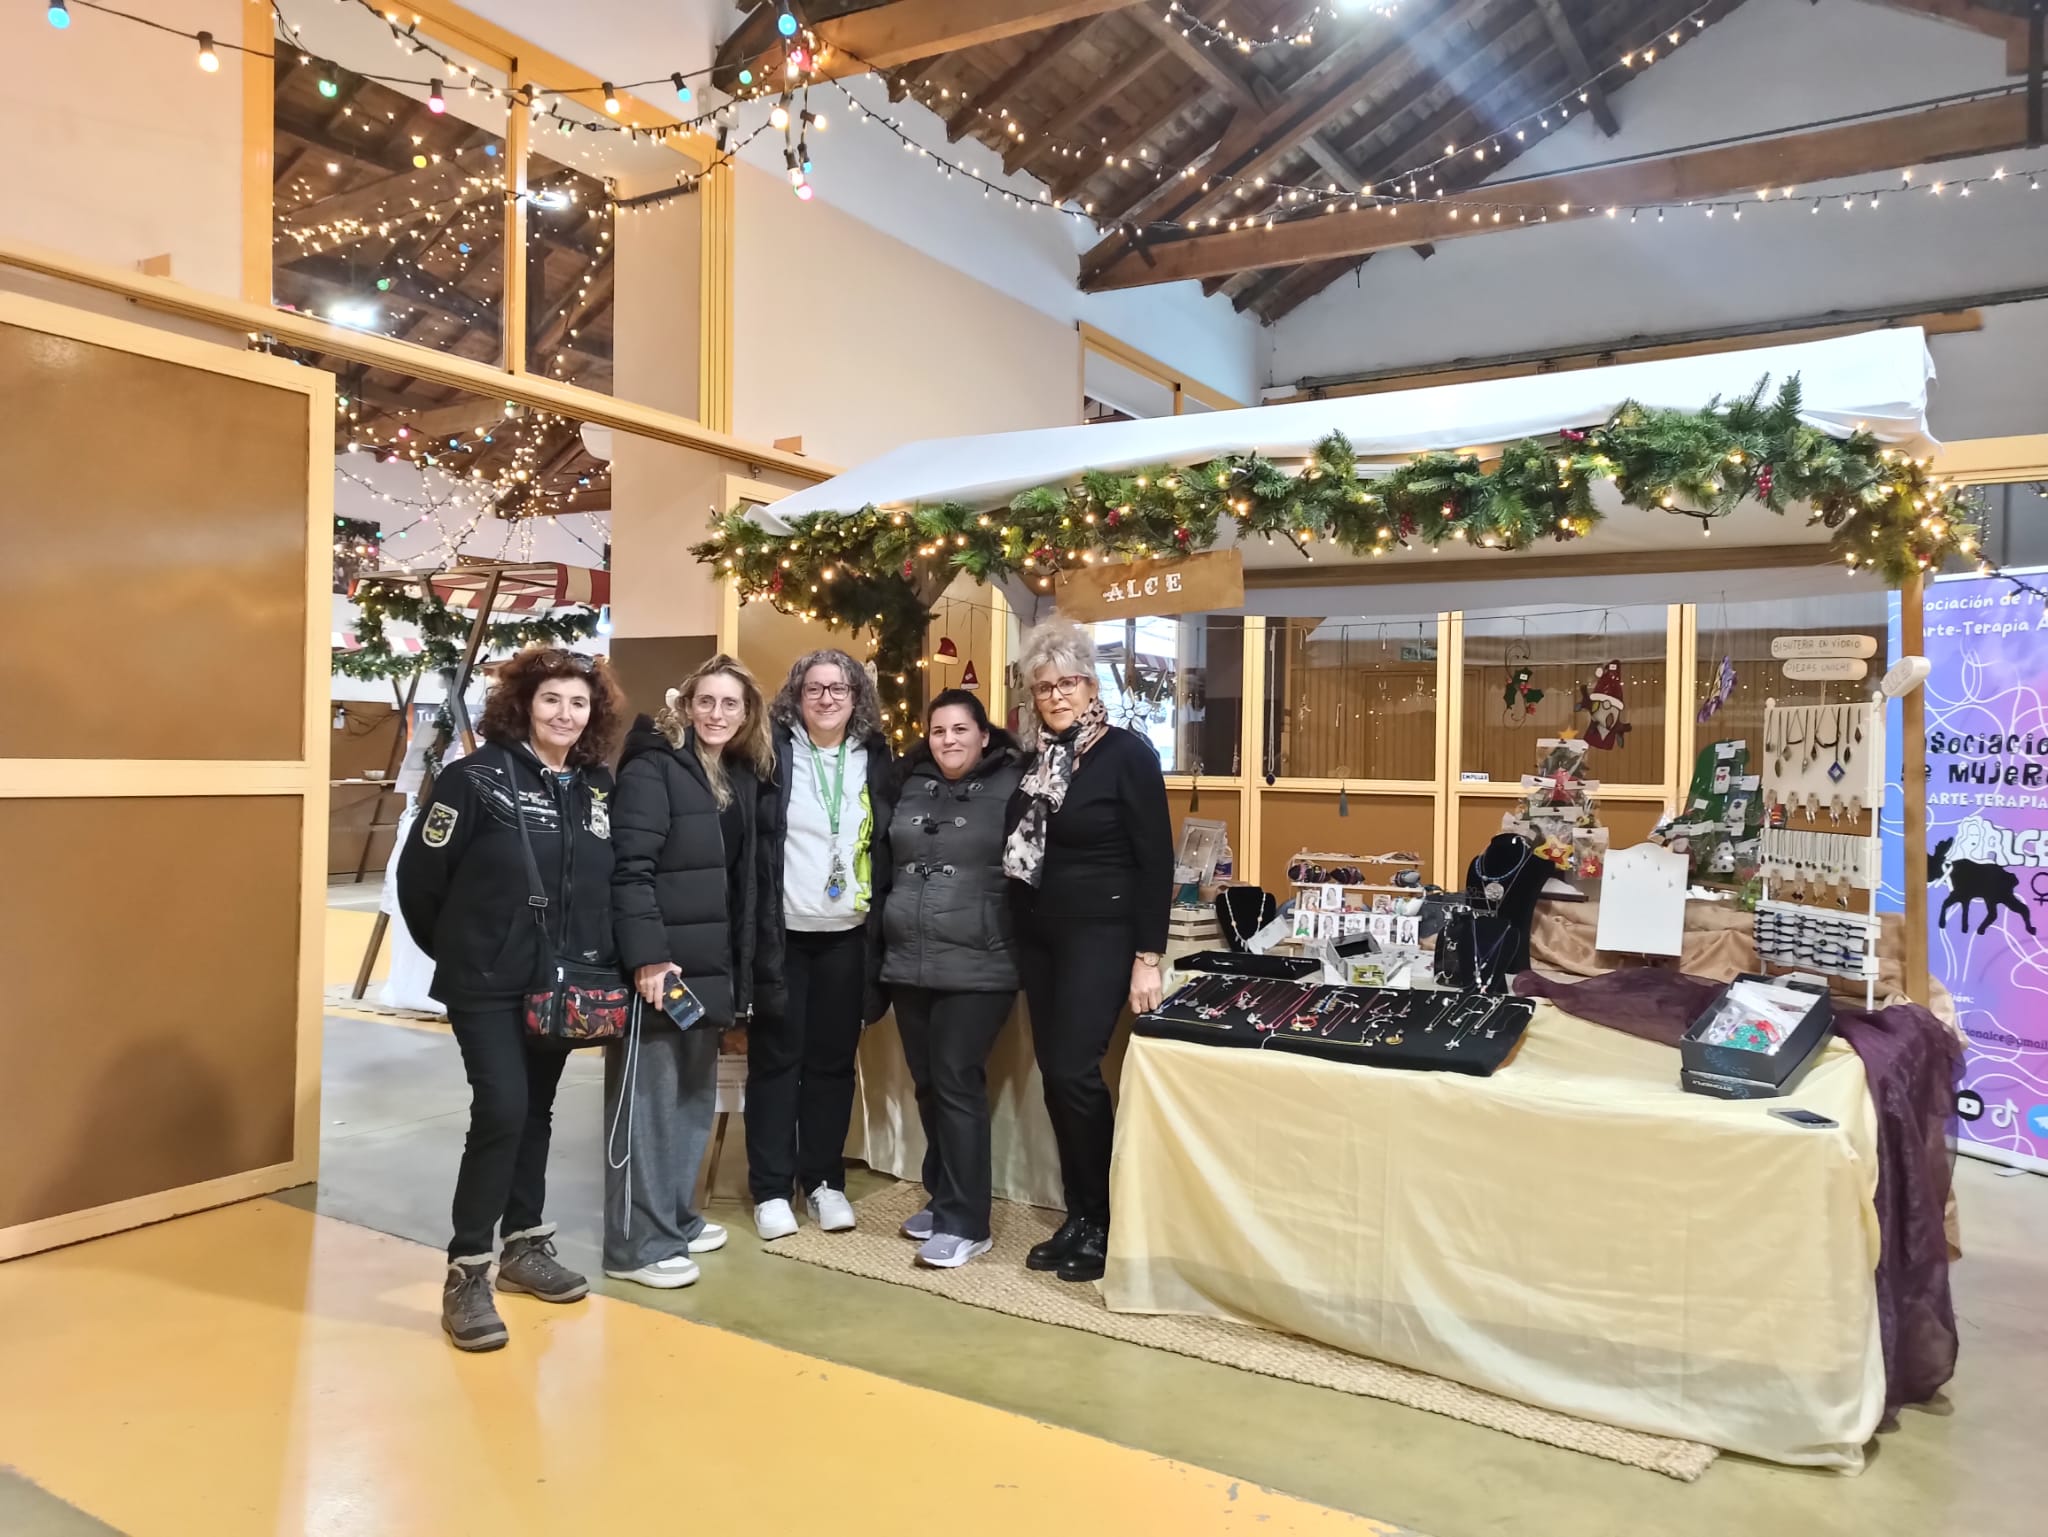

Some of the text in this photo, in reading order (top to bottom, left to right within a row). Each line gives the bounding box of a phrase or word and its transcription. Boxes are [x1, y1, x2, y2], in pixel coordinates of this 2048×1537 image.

[1102, 572, 1182, 602] ALCE
[1922, 594, 1993, 611] ociación
[1999, 590, 2020, 606] de
[1928, 792, 2048, 808] ARTE-TERAPIA
